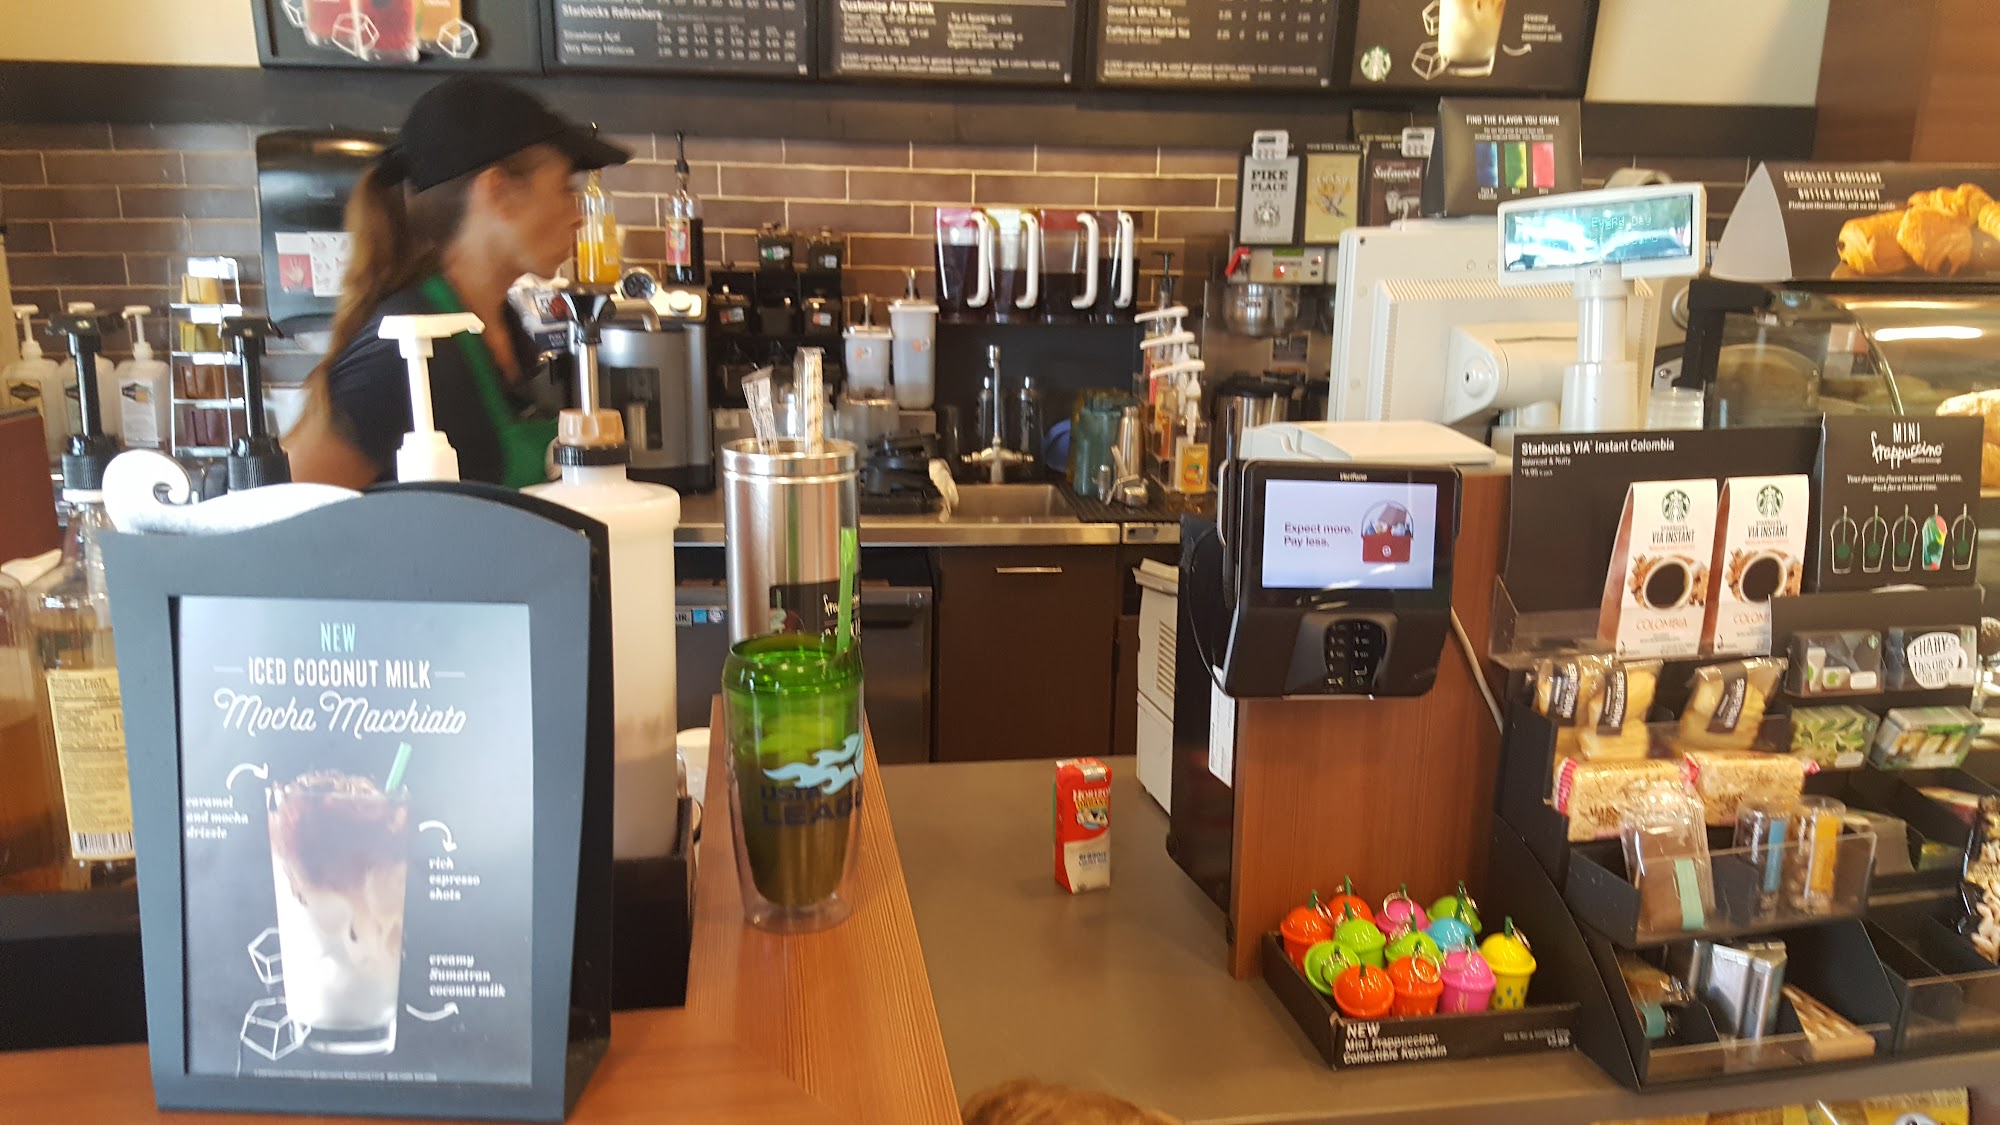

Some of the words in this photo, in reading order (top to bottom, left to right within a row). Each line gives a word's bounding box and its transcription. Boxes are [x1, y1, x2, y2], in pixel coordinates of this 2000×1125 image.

[889, 1, 909, 16] Any
[909, 2, 935, 15] Drink
[1466, 114, 1482, 125] FIND
[1483, 114, 1497, 125] THE
[1498, 115, 1523, 126] FLAVOR
[1524, 115, 1538, 126] YOU
[1251, 169, 1289, 181] PIKE
[1250, 183, 1288, 192] PLACE
[1893, 422, 1920, 443] MINI
[1521, 441, 1571, 456] Starbucks
[1595, 439, 1629, 454] Instant
[1631, 438, 1675, 452] Colombia
[1339, 472, 1368, 482] Verifone
[1284, 523, 1322, 535] Expect
[1748, 526, 1759, 538] VIA
[1760, 525, 1788, 538] INSTANT
[1284, 535, 1303, 548] Pay
[1652, 532, 1665, 544] VIA
[1665, 530, 1696, 544] INSTANT
[1636, 616, 1689, 632] COLOMBIA
[320, 622, 356, 652] NEW
[248, 656, 287, 686] ICED
[293, 659, 379, 688] COCONUT
[385, 660, 431, 689] MILK
[213, 687, 317, 737] Mocha
[319, 690, 467, 740] Macchiato
[185, 795, 234, 809] caramel
[186, 811, 209, 824] and
[210, 812, 249, 825] mocha
[187, 826, 228, 839] drizzle
[429, 856, 454, 870] rich
[429, 873, 480, 888] espresso
[429, 888, 461, 901] shots
[429, 954, 475, 969] creamy
[429, 969, 491, 983] Sumatran
[429, 984, 476, 998] coconut
[478, 984, 506, 998] milk
[1346, 1021, 1380, 1039] NEW
[1345, 1037, 1369, 1052] Mini
[1343, 1047, 1399, 1065] Collectible
[1401, 1043, 1448, 1060] Keychain
